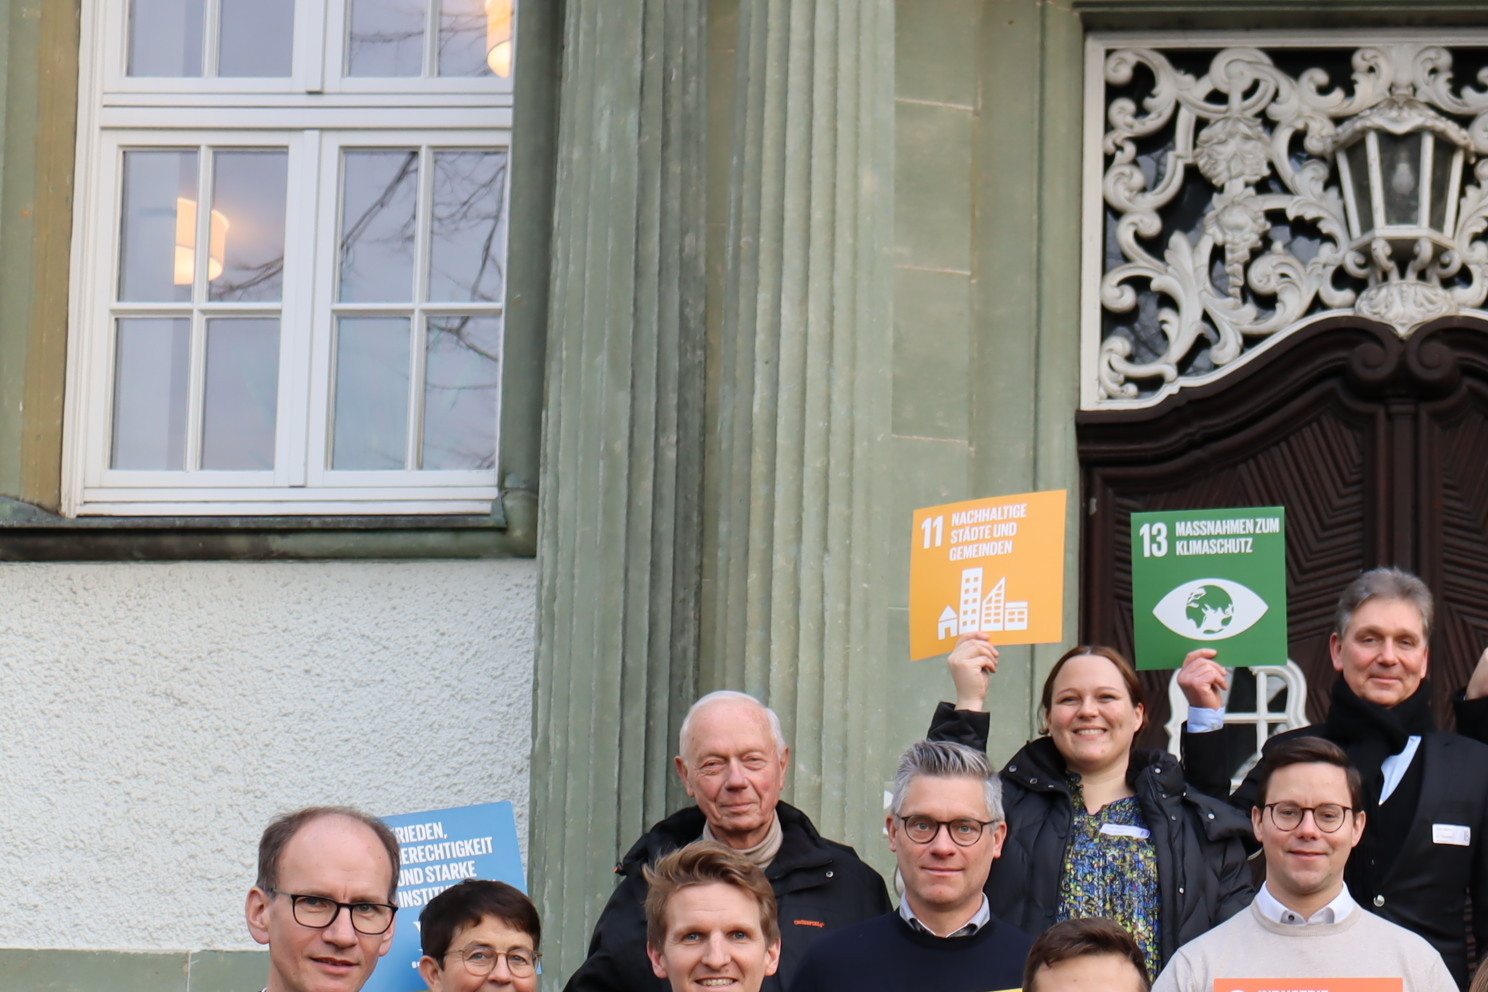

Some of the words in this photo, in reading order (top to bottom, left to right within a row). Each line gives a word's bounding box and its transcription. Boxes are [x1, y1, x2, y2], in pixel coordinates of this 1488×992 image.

[951, 504, 1028, 526] NACHHALTIGE
[920, 515, 943, 549] 11
[950, 522, 992, 544] STÄDTE
[993, 522, 1017, 539] UND
[1175, 519, 1253, 537] MASSNAHMEN
[1254, 517, 1280, 533] ZUM
[949, 540, 1013, 561] GEMEINDEN
[1139, 522, 1169, 558] 13
[1175, 538, 1253, 556] KLIMASCHUTZ
[399, 836, 493, 865] ERECHTIGKEIT
[425, 860, 477, 883] STARKE
